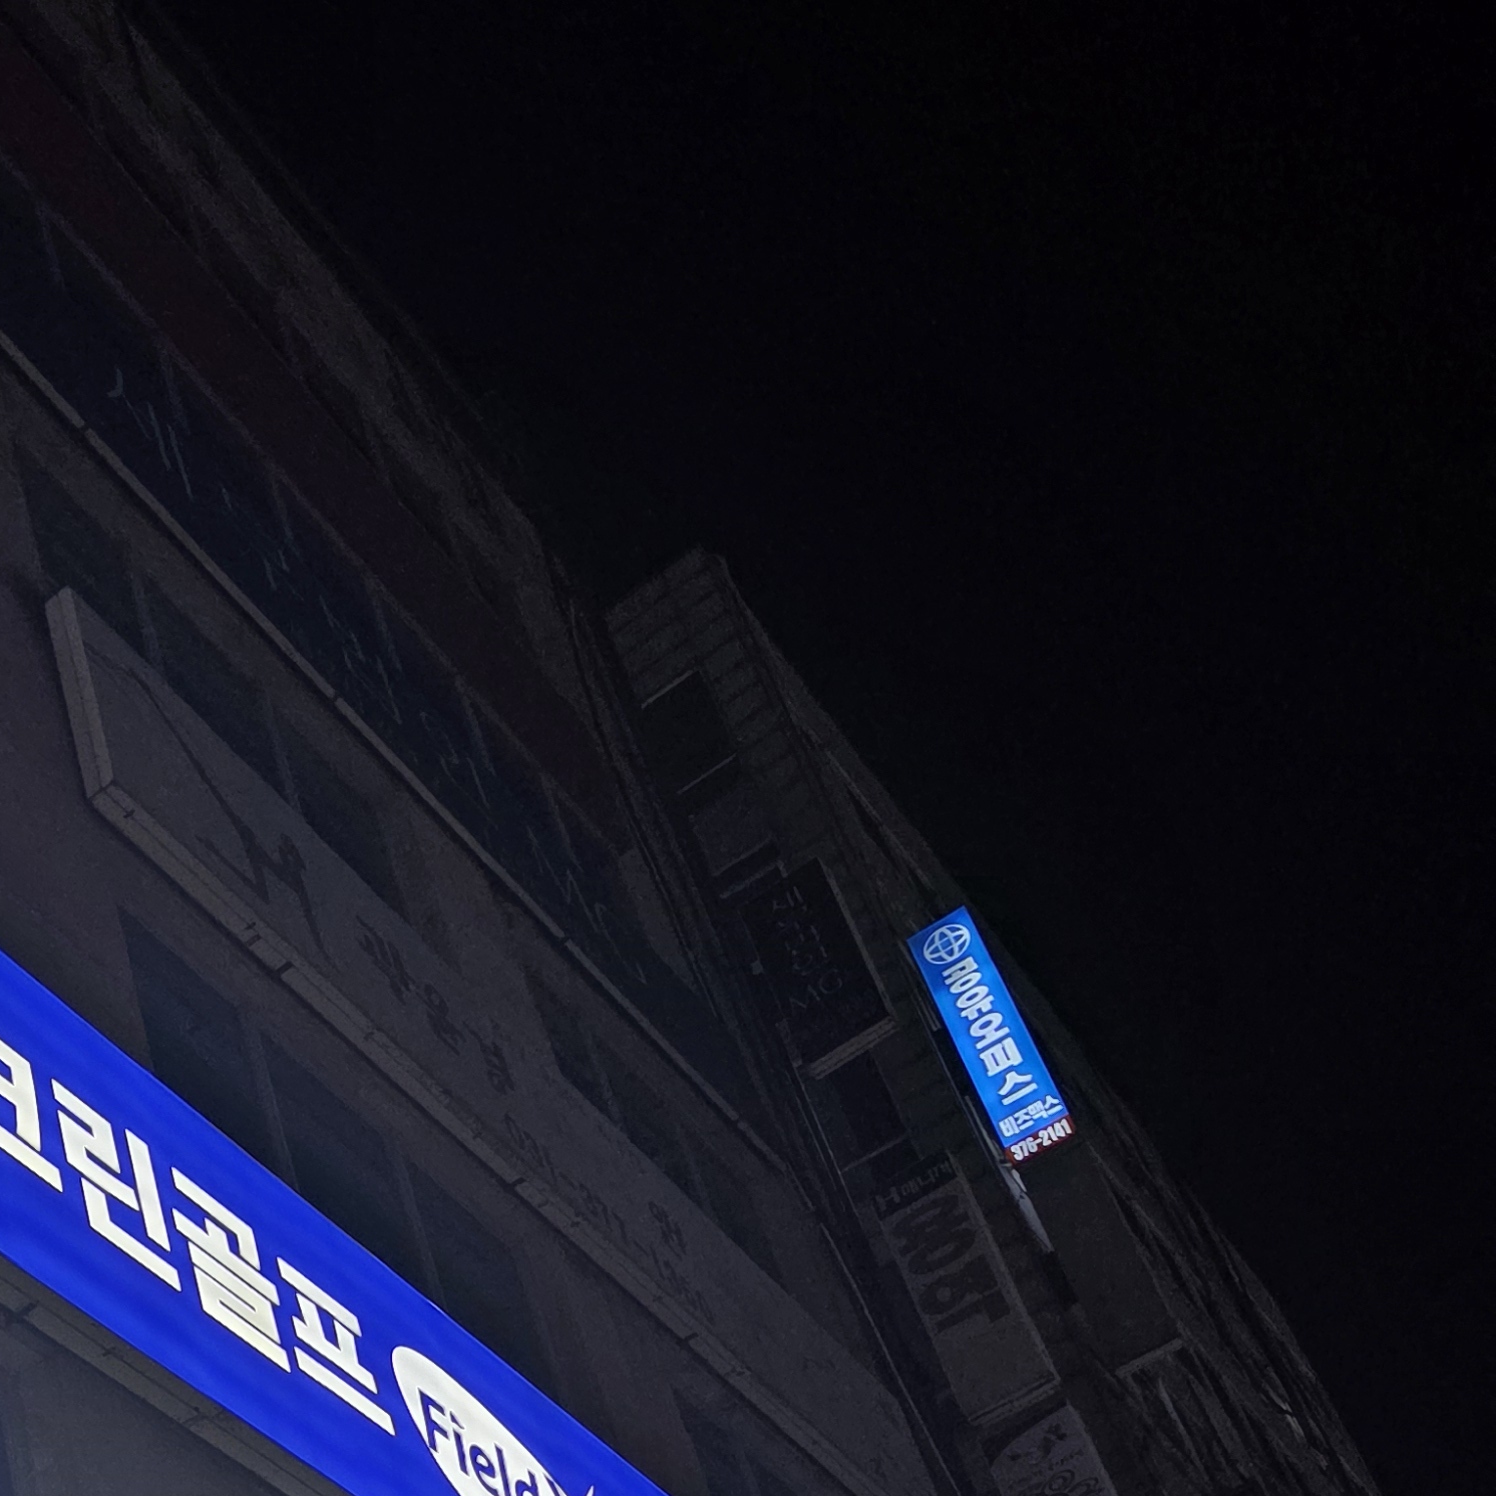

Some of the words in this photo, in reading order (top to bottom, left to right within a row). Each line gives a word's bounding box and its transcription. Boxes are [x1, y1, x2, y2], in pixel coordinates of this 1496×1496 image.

[941, 956, 1039, 1106] 공유오피스
[998, 1094, 1064, 1137] 비즈맥스
[1010, 1118, 1072, 1161] 376-2141
